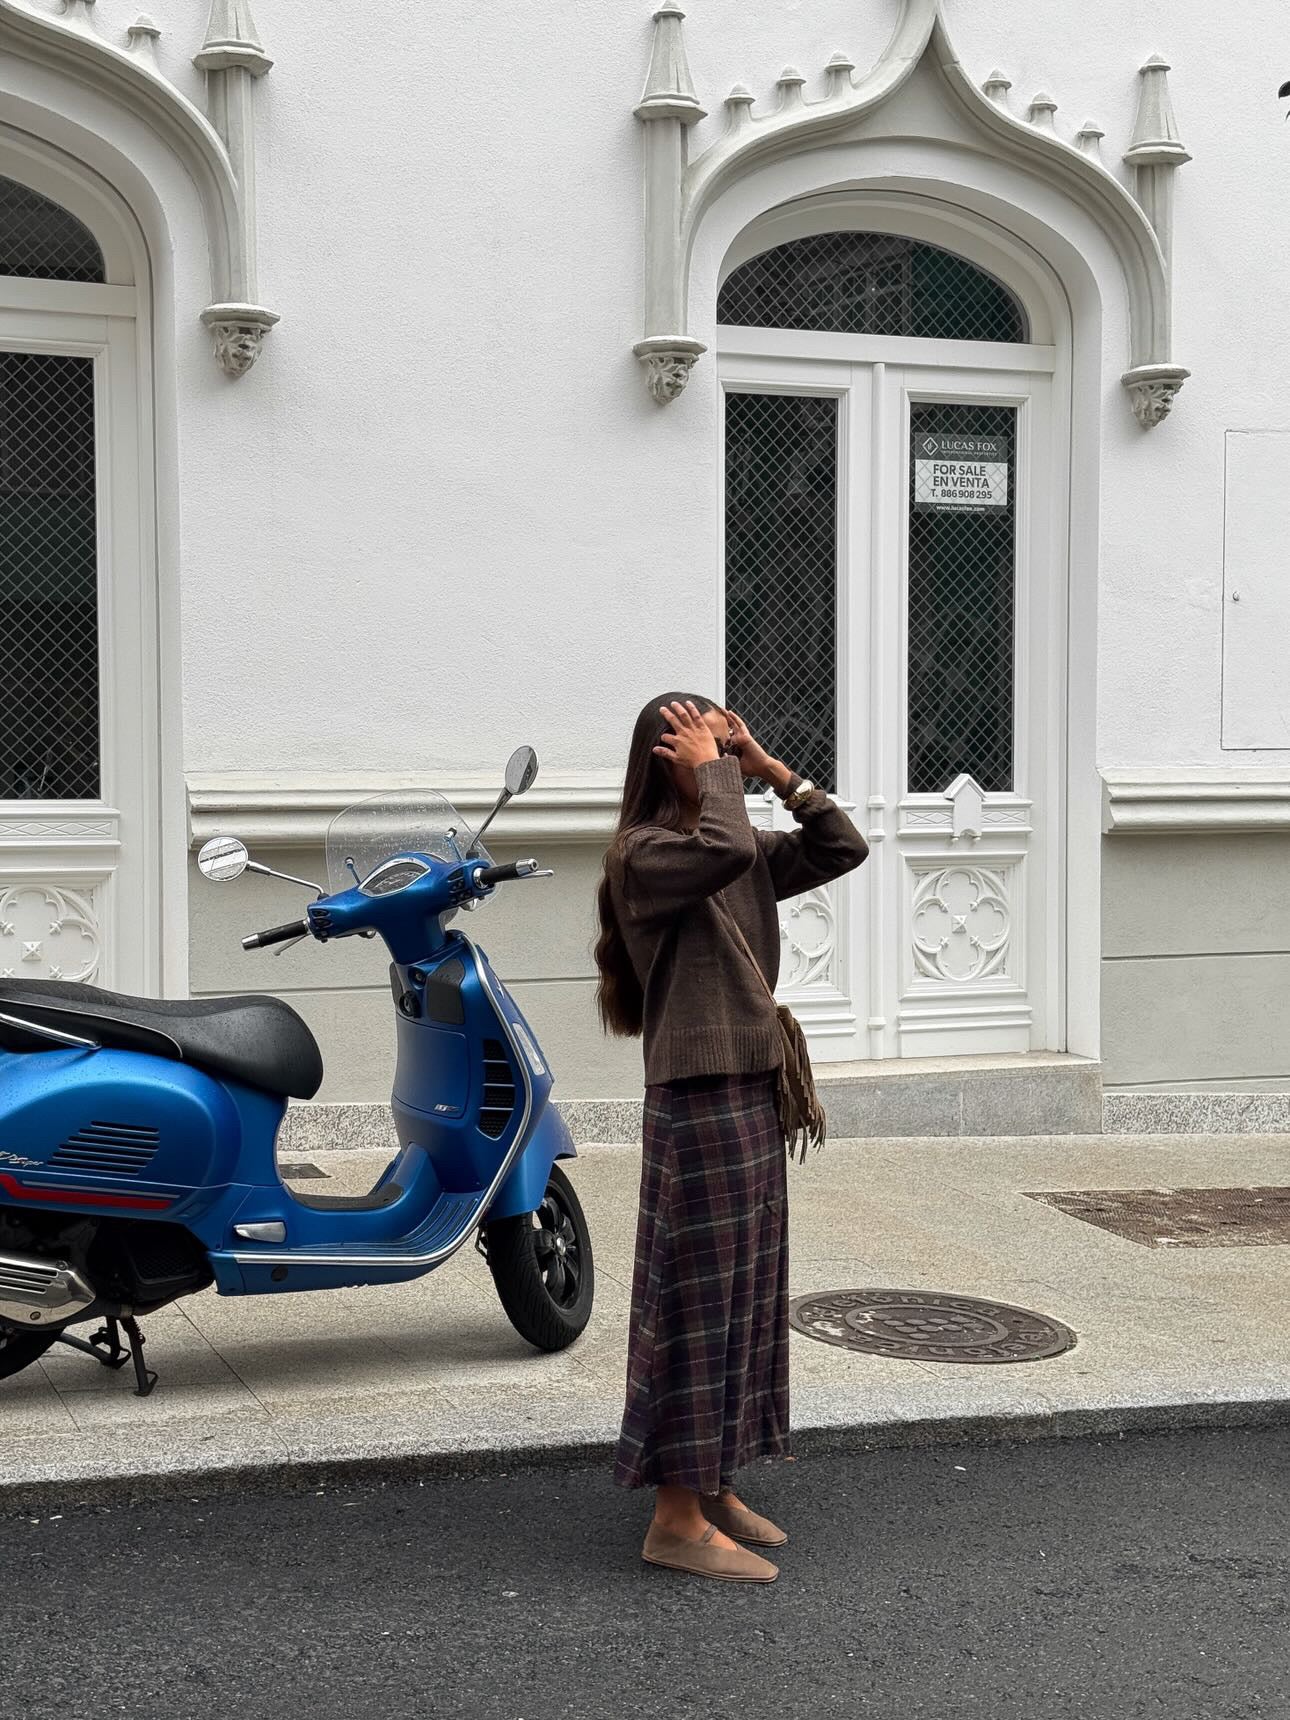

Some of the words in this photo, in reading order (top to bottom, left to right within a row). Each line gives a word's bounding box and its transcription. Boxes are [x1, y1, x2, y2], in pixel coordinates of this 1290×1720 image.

[941, 440, 975, 450] LUCAS
[977, 442, 997, 452] FOX
[933, 464, 956, 475] FOR
[958, 465, 986, 476] SALE
[933, 476, 948, 487] EN
[951, 477, 990, 488] VENTA
[930, 488, 938, 497] T.
